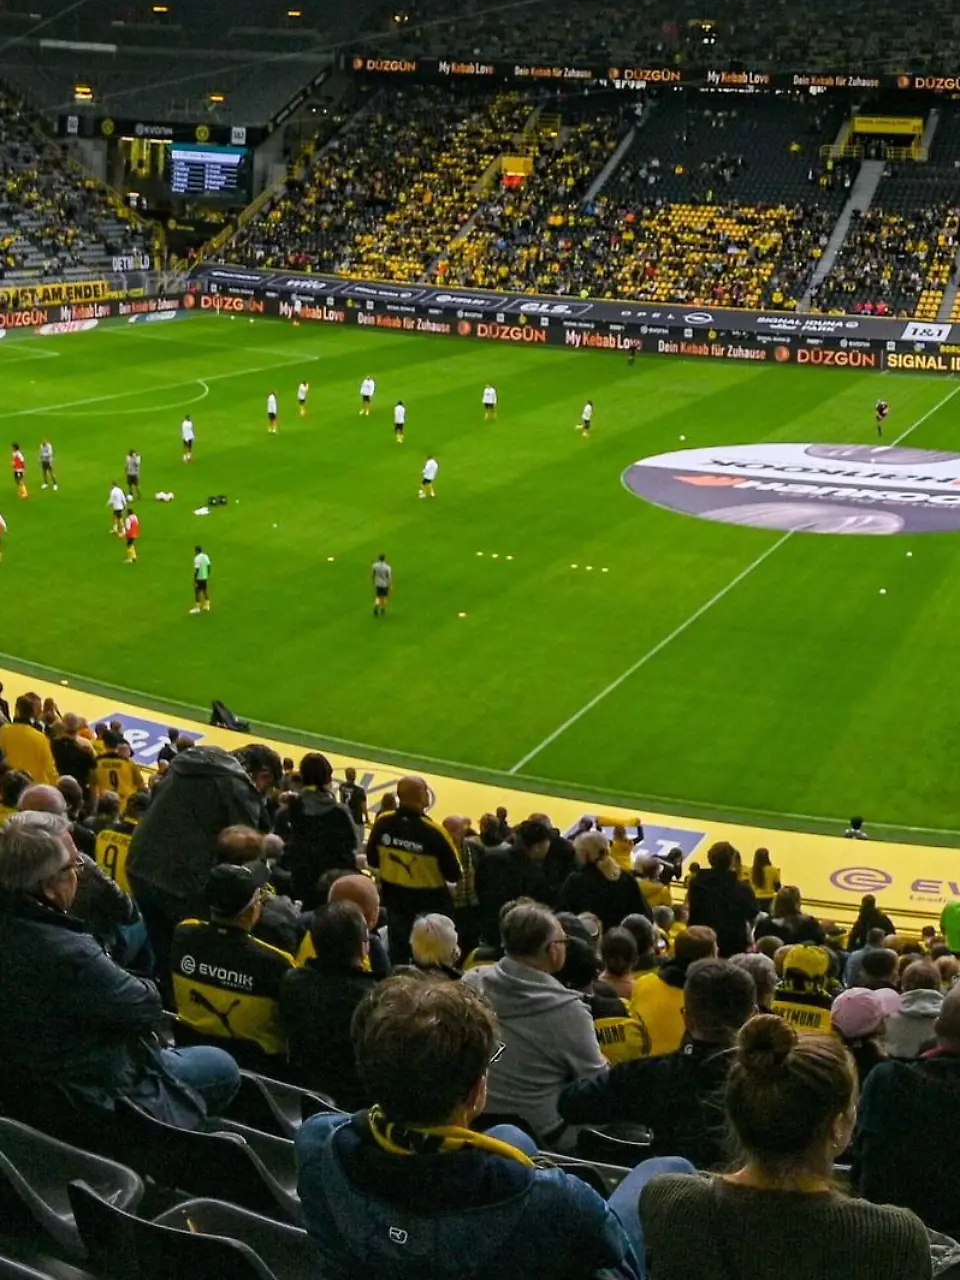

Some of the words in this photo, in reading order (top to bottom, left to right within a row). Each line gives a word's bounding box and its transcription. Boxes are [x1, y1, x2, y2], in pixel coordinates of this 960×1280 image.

[708, 71, 720, 85] My
[279, 301, 292, 318] My
[477, 323, 546, 342] DÜZGÜN
[565, 329, 582, 348] My
[583, 331, 615, 348] Kebab
[911, 328, 943, 338] 1&1
[658, 340, 678, 354] Dein
[680, 341, 709, 356] Kebab
[711, 342, 725, 356] für
[727, 344, 766, 360] Zuhause
[797, 347, 876, 367] DÜZGÜN
[887, 353, 947, 371] SIGNAL
[199, 963, 254, 987] EVONIK
